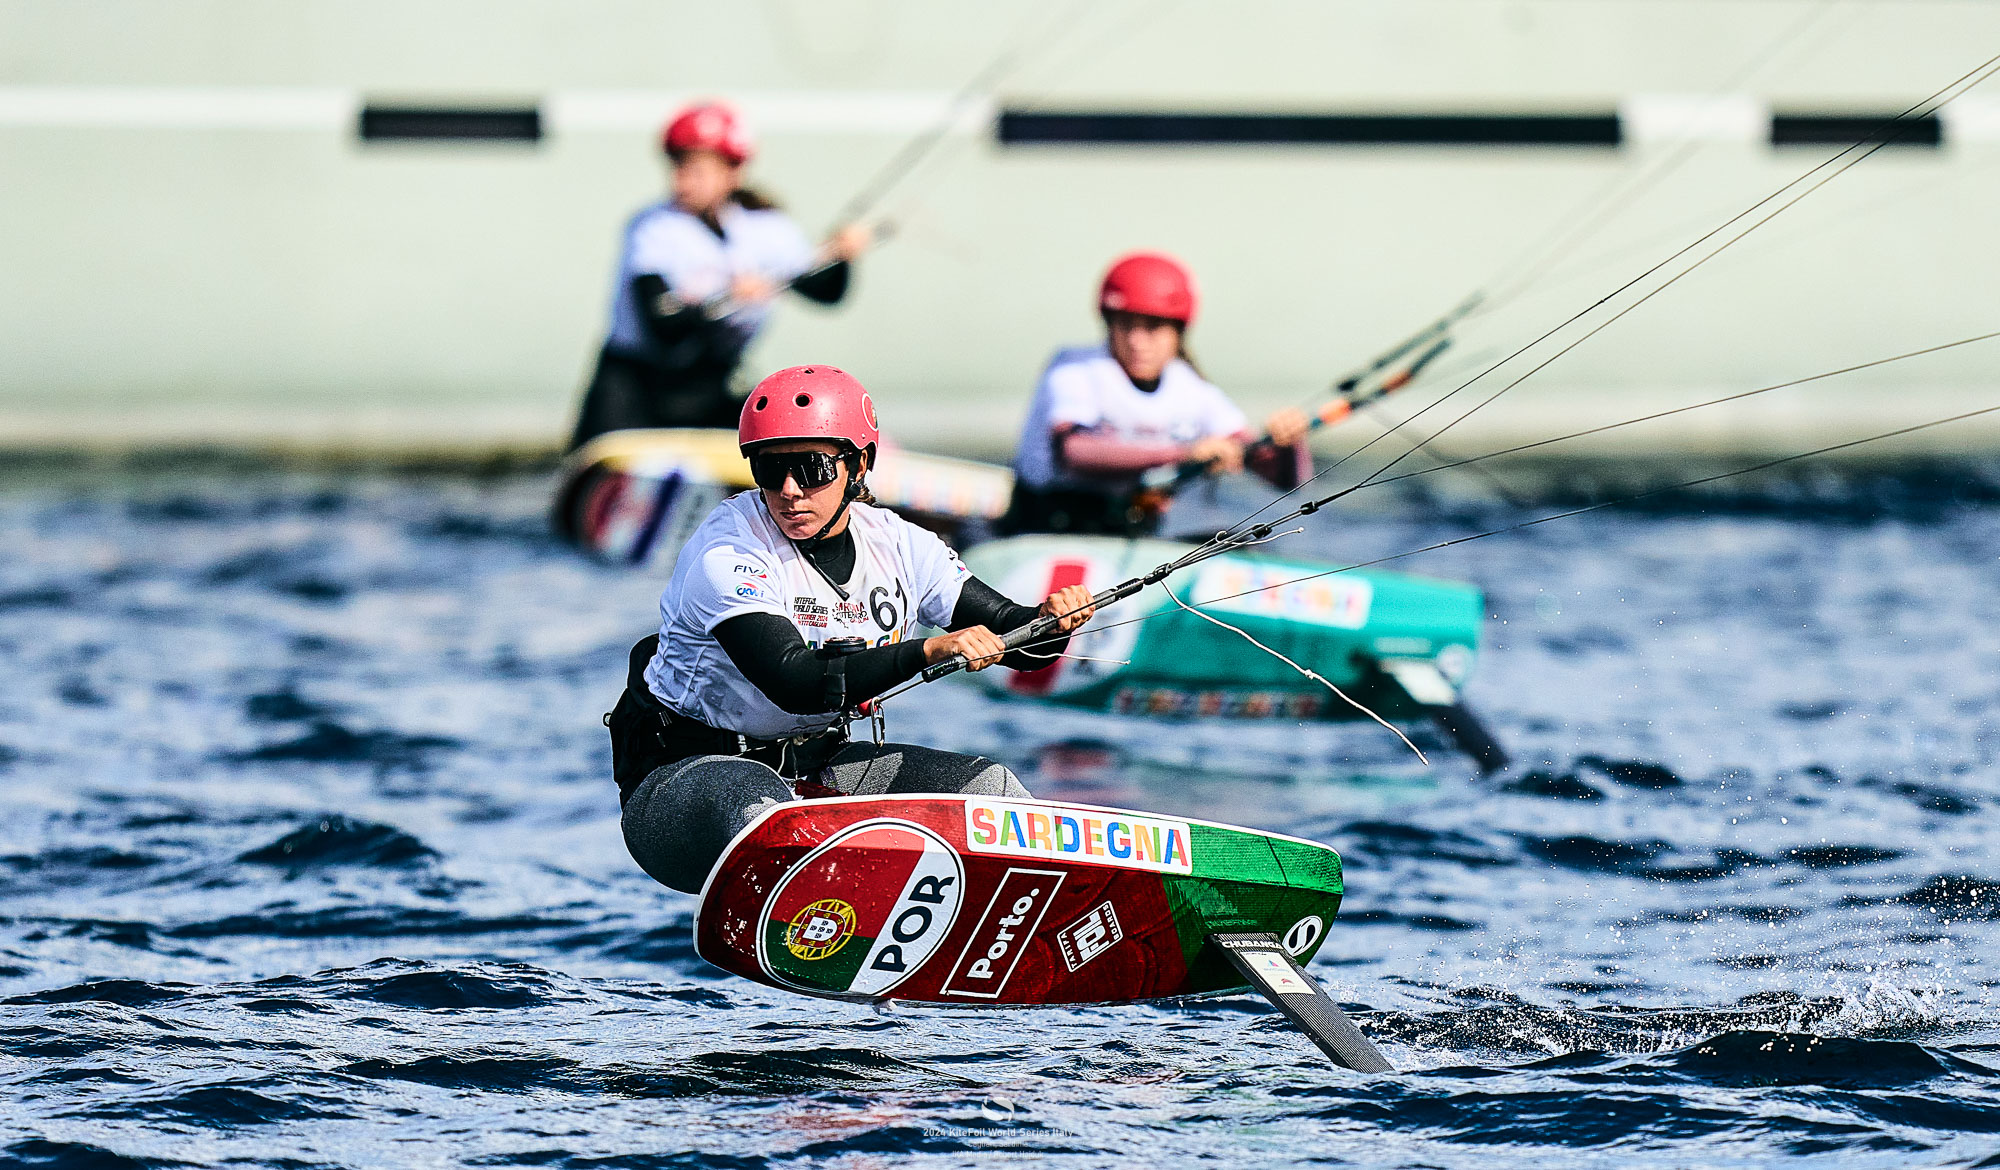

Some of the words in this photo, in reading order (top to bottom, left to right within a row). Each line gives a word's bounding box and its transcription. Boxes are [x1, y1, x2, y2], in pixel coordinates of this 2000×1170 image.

[869, 577, 907, 632] 61
[972, 808, 1188, 866] SARDEGNA
[870, 876, 955, 972] POR
[967, 888, 1039, 978] Porto.
[1103, 904, 1119, 940] BOARDS
[1222, 940, 1283, 949] CHUBANGA
[1060, 932, 1077, 968] TARIFA
